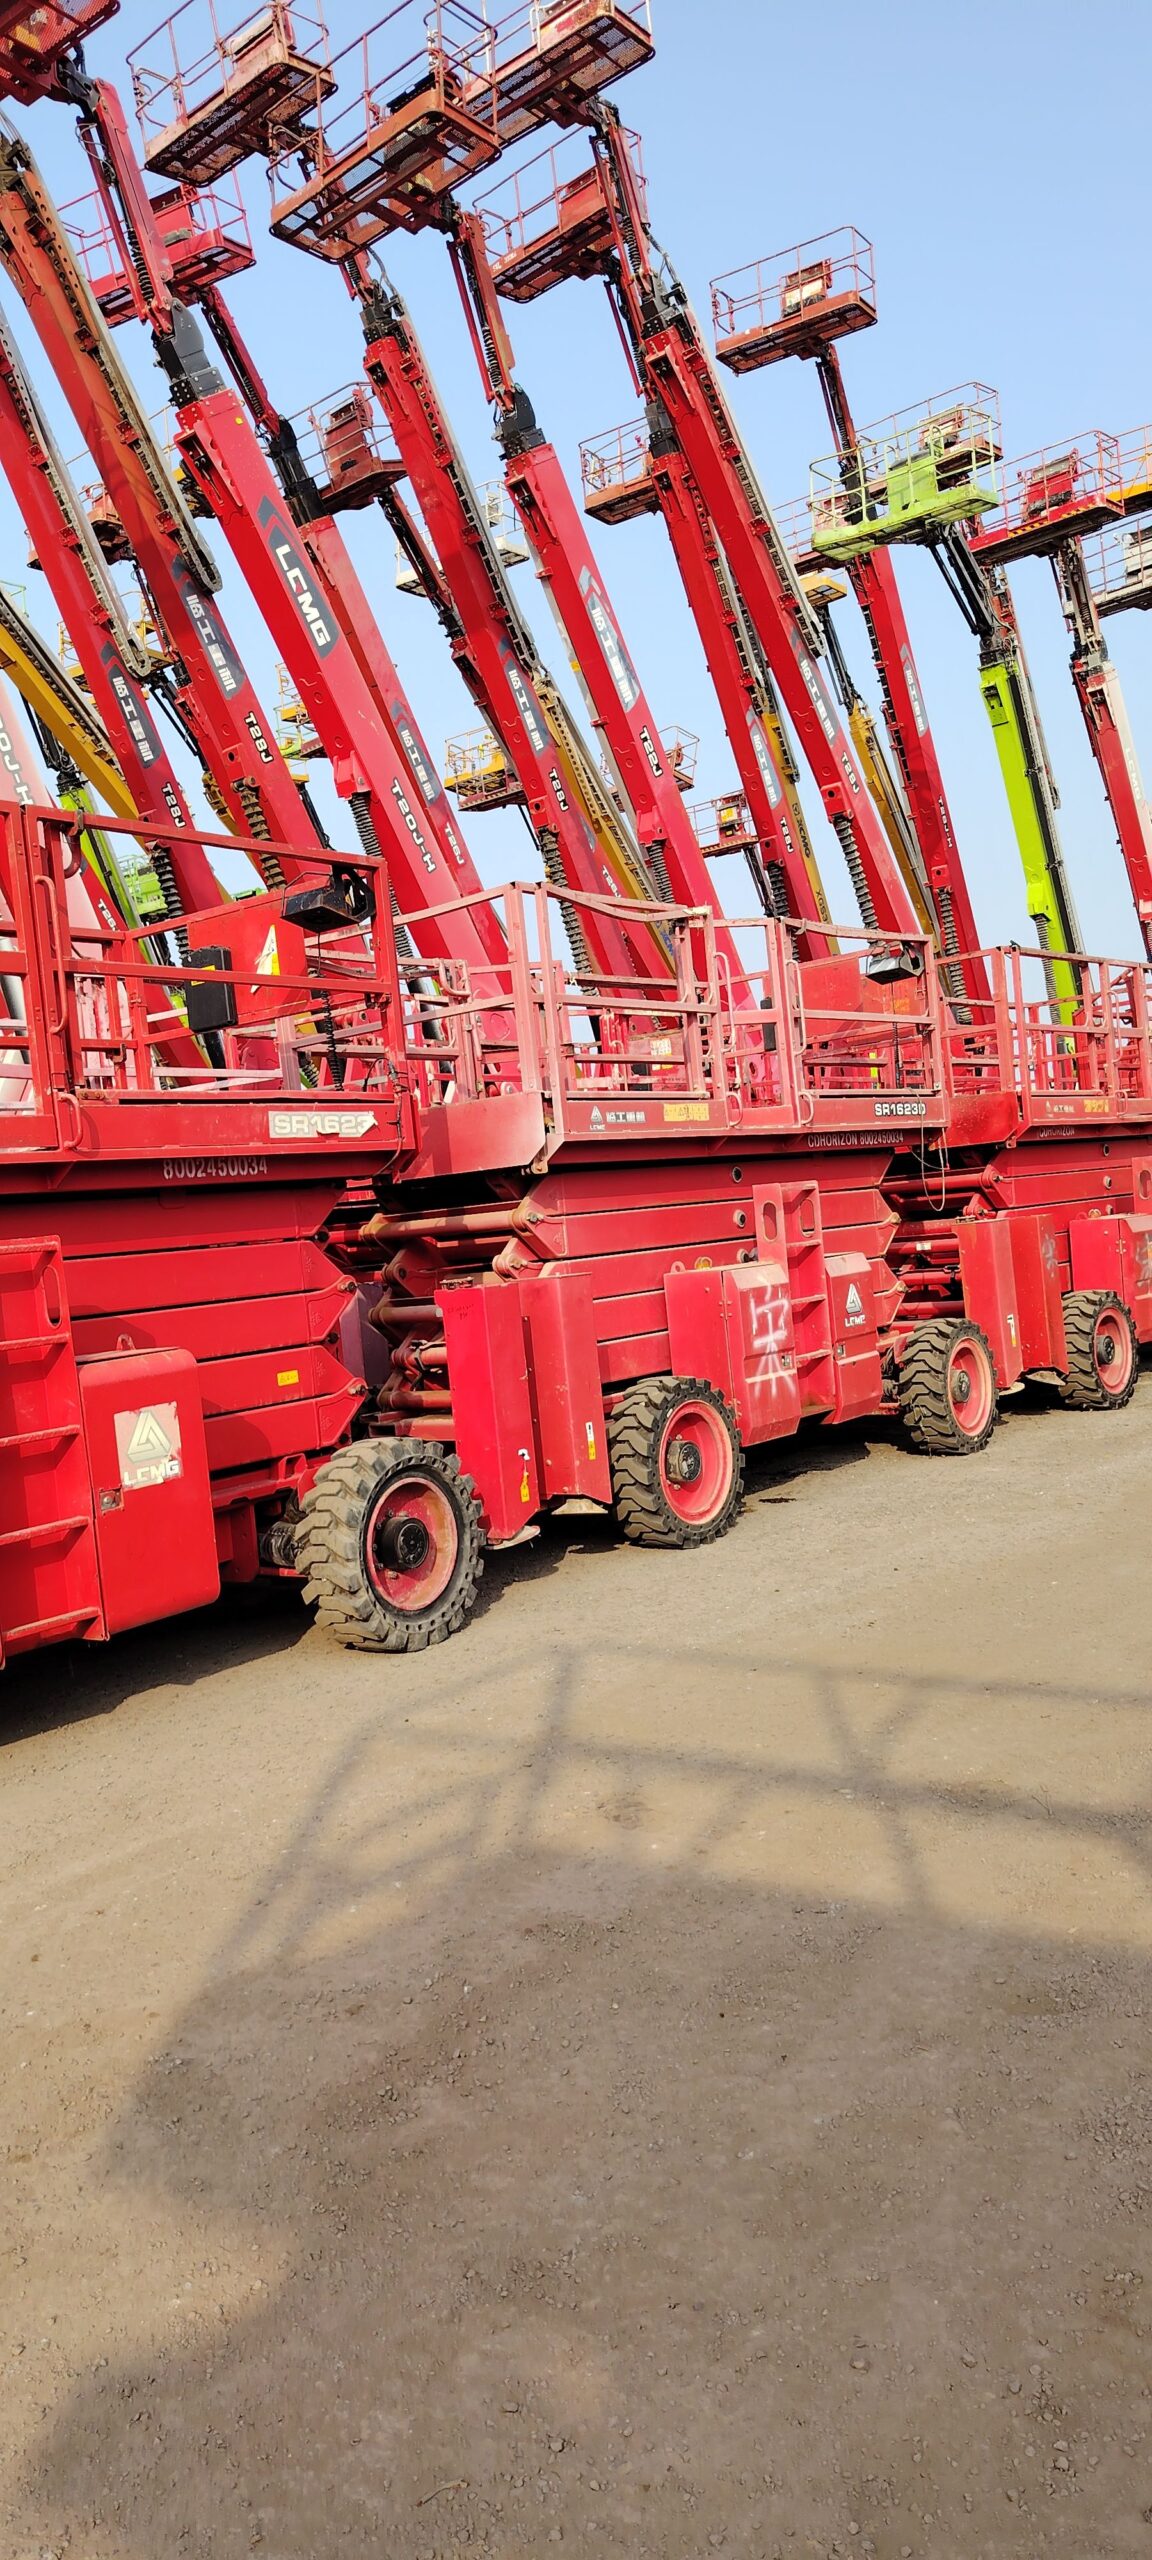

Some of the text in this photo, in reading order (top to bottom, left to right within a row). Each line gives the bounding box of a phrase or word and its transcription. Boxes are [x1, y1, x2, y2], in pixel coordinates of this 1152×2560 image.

[276, 544, 331, 647] LCMG
[244, 711, 274, 764] T28J
[640, 726, 664, 778] T22J
[548, 767, 569, 811] T28J
[842, 752, 860, 794] T28J
[161, 782, 186, 828] T28J
[391, 778, 437, 874] T20J-H
[808, 1132, 858, 1148] CDHORIZON
[163, 1156, 268, 1180] 8002450034
